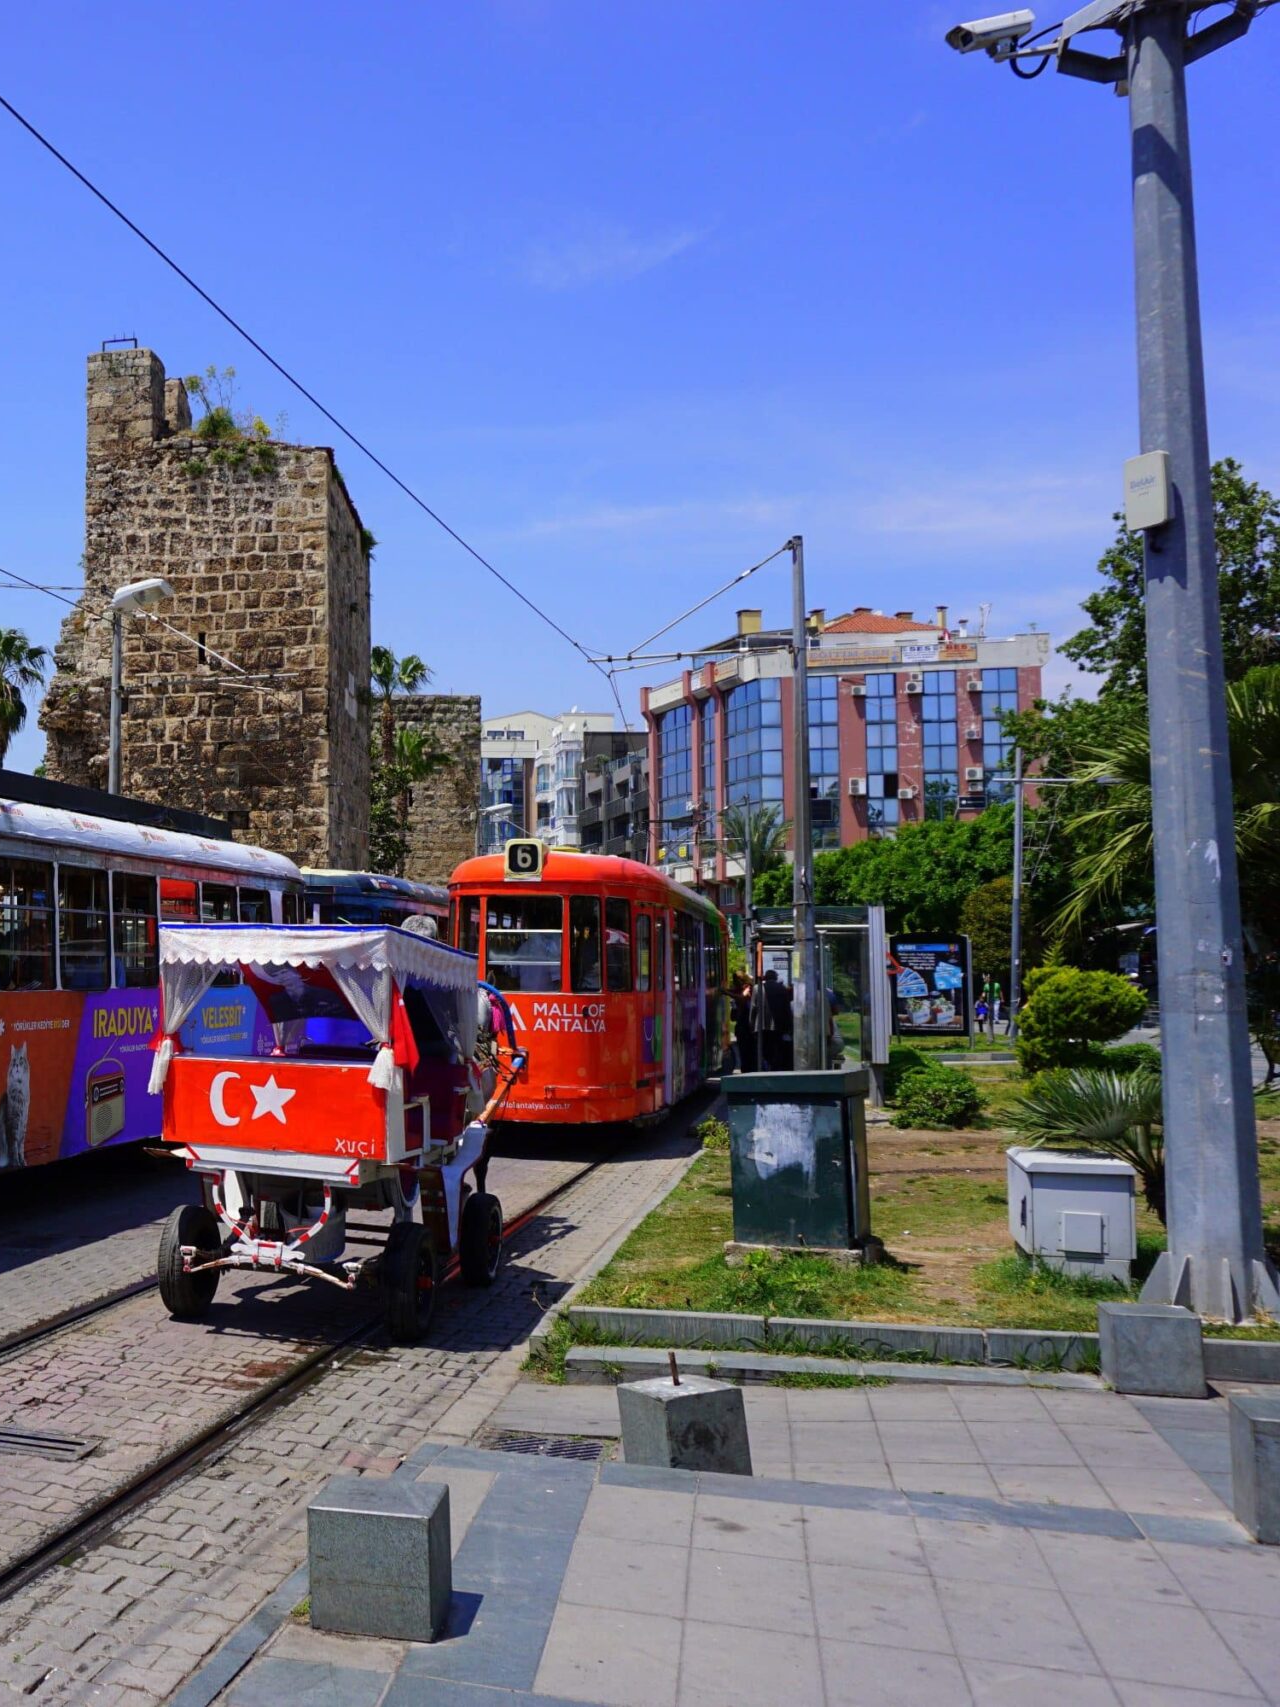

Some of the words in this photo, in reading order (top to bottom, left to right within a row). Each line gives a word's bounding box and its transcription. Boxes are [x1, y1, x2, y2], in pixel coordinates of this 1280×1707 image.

[516, 845, 533, 868] 6
[533, 1002, 583, 1017] MALL
[588, 1004, 605, 1017] OF
[533, 1018, 606, 1033] ANTALYA
